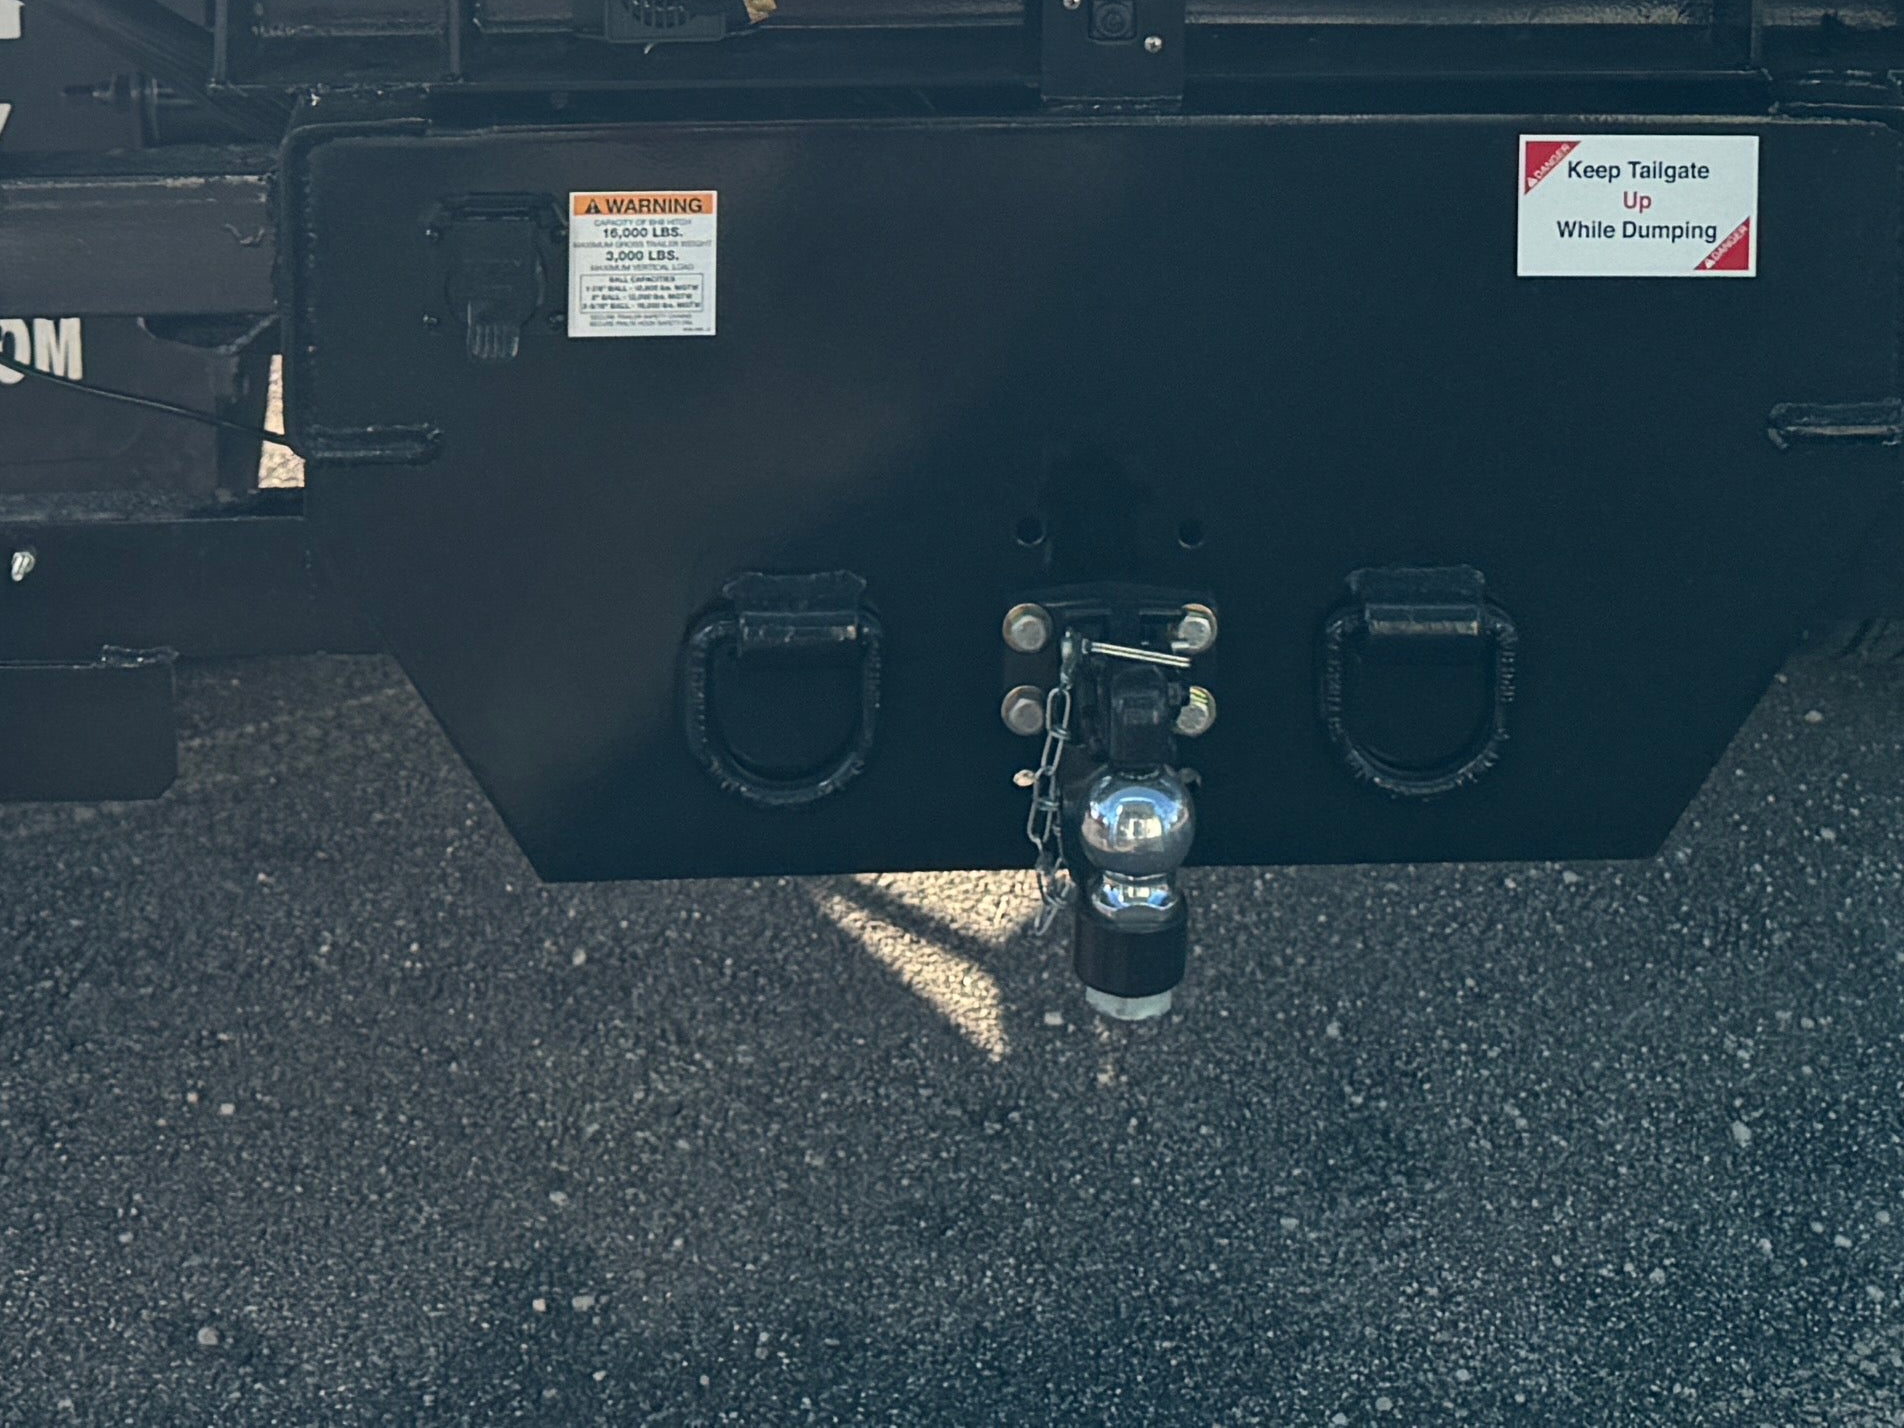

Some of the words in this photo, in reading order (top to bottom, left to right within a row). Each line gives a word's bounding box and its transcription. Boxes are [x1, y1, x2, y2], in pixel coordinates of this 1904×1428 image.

[1534, 143, 1570, 180] DANGER
[1567, 160, 1621, 183] Keep
[1628, 160, 1710, 182] Tailgate
[606, 198, 703, 213] WARNING
[1623, 190, 1652, 213] Up
[603, 227, 648, 239] 16,000
[651, 226, 683, 238] LBS.
[1557, 220, 1616, 240] While
[1622, 221, 1718, 243] Dumping
[1711, 224, 1748, 262] DANGER
[605, 250, 644, 262] 3,000
[647, 250, 678, 261] LBS.
